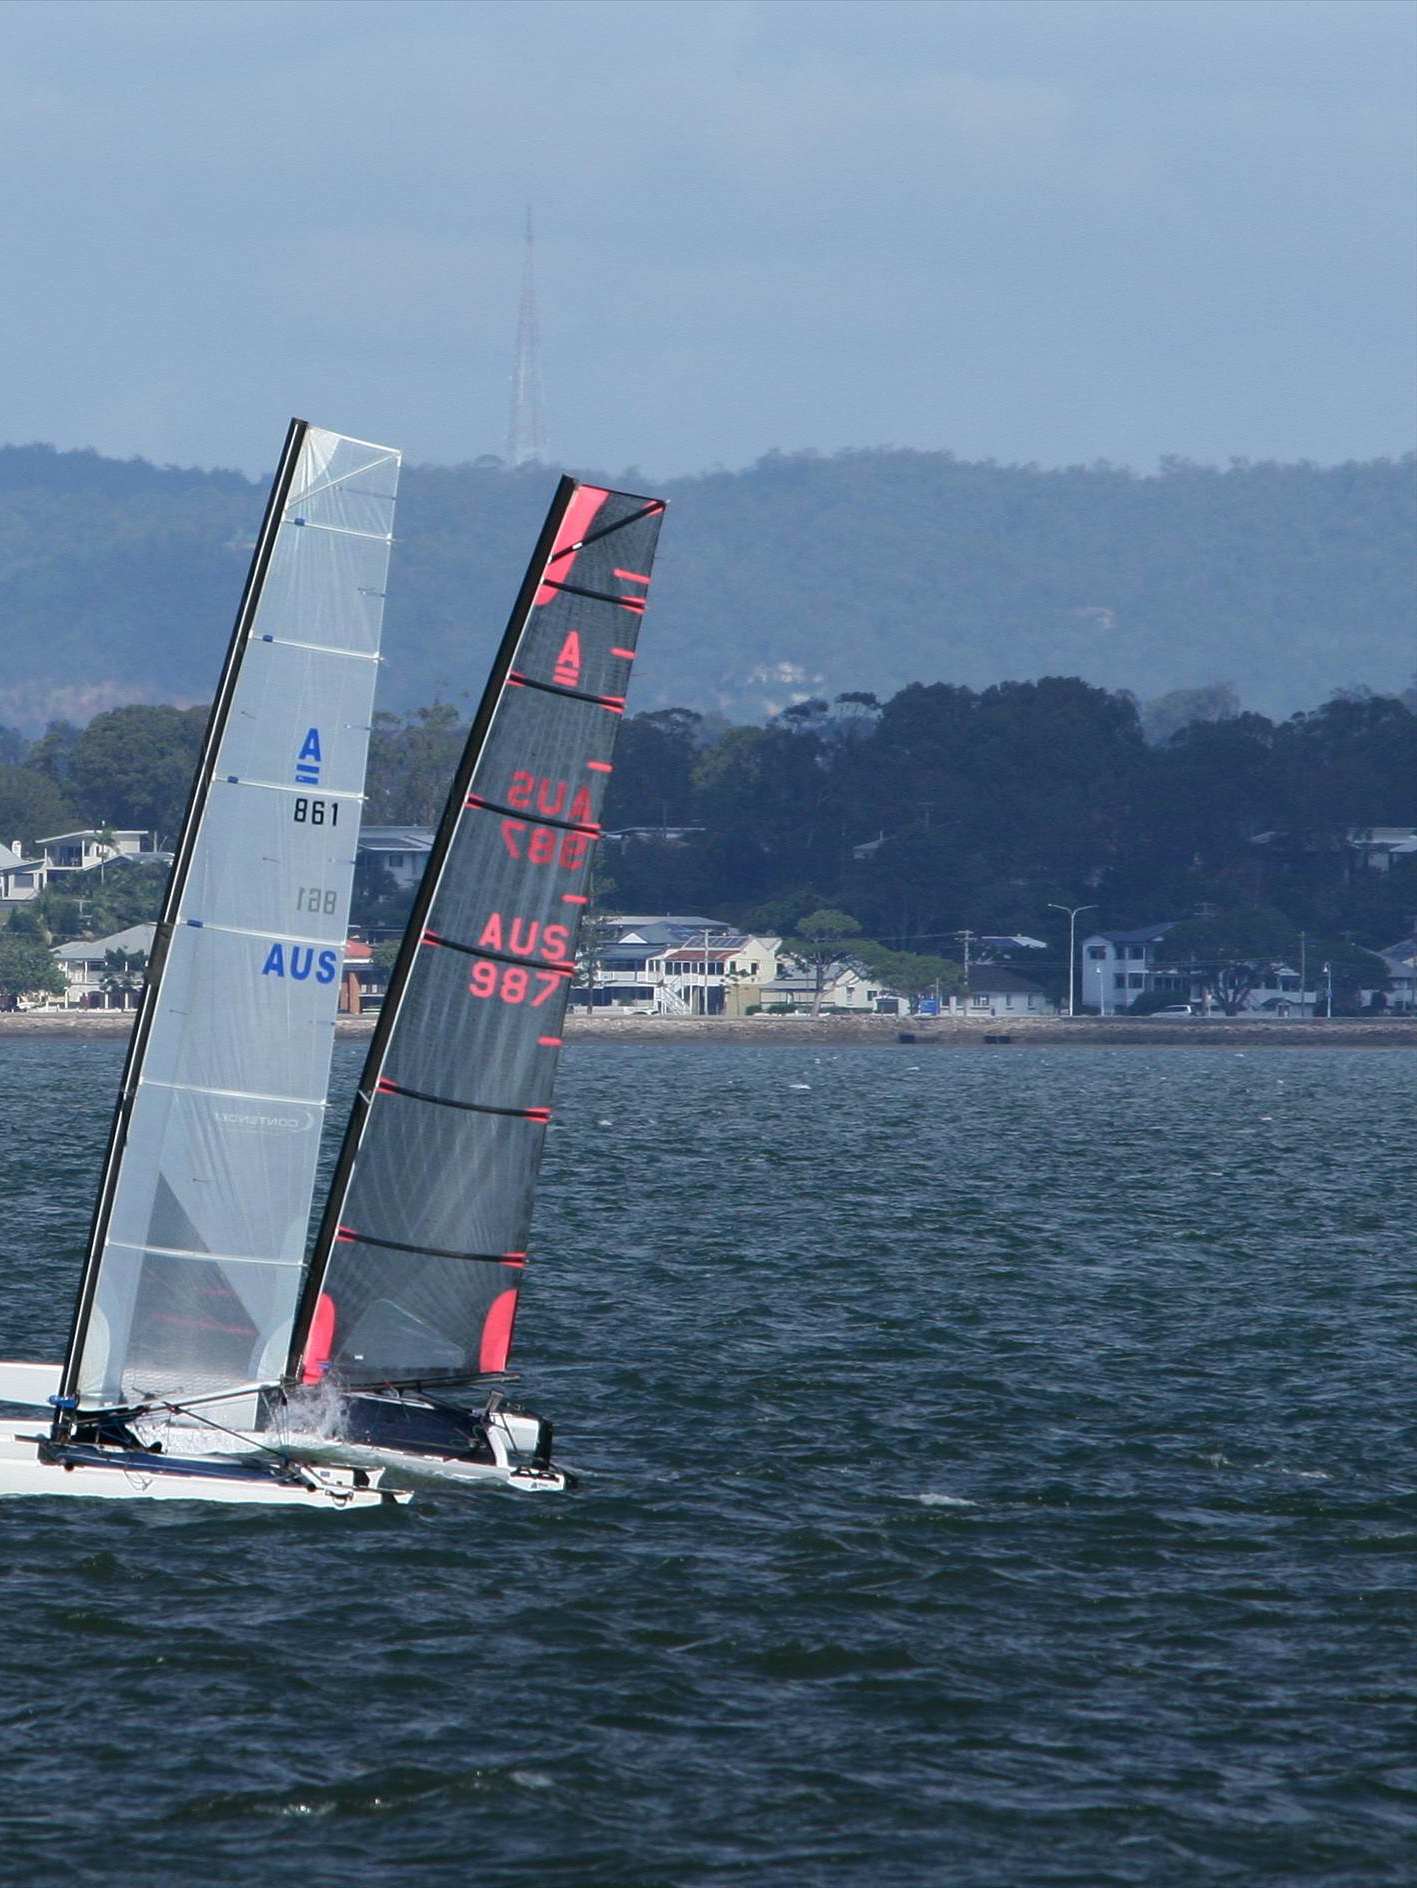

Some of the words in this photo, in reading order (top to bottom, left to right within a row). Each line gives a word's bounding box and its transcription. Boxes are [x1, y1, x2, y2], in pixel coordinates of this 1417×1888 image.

[558, 630, 581, 668] A
[298, 728, 322, 762] A
[294, 798, 339, 826] 861
[478, 912, 569, 960] AUS
[262, 943, 337, 984] AUS
[469, 961, 560, 1007] 987
